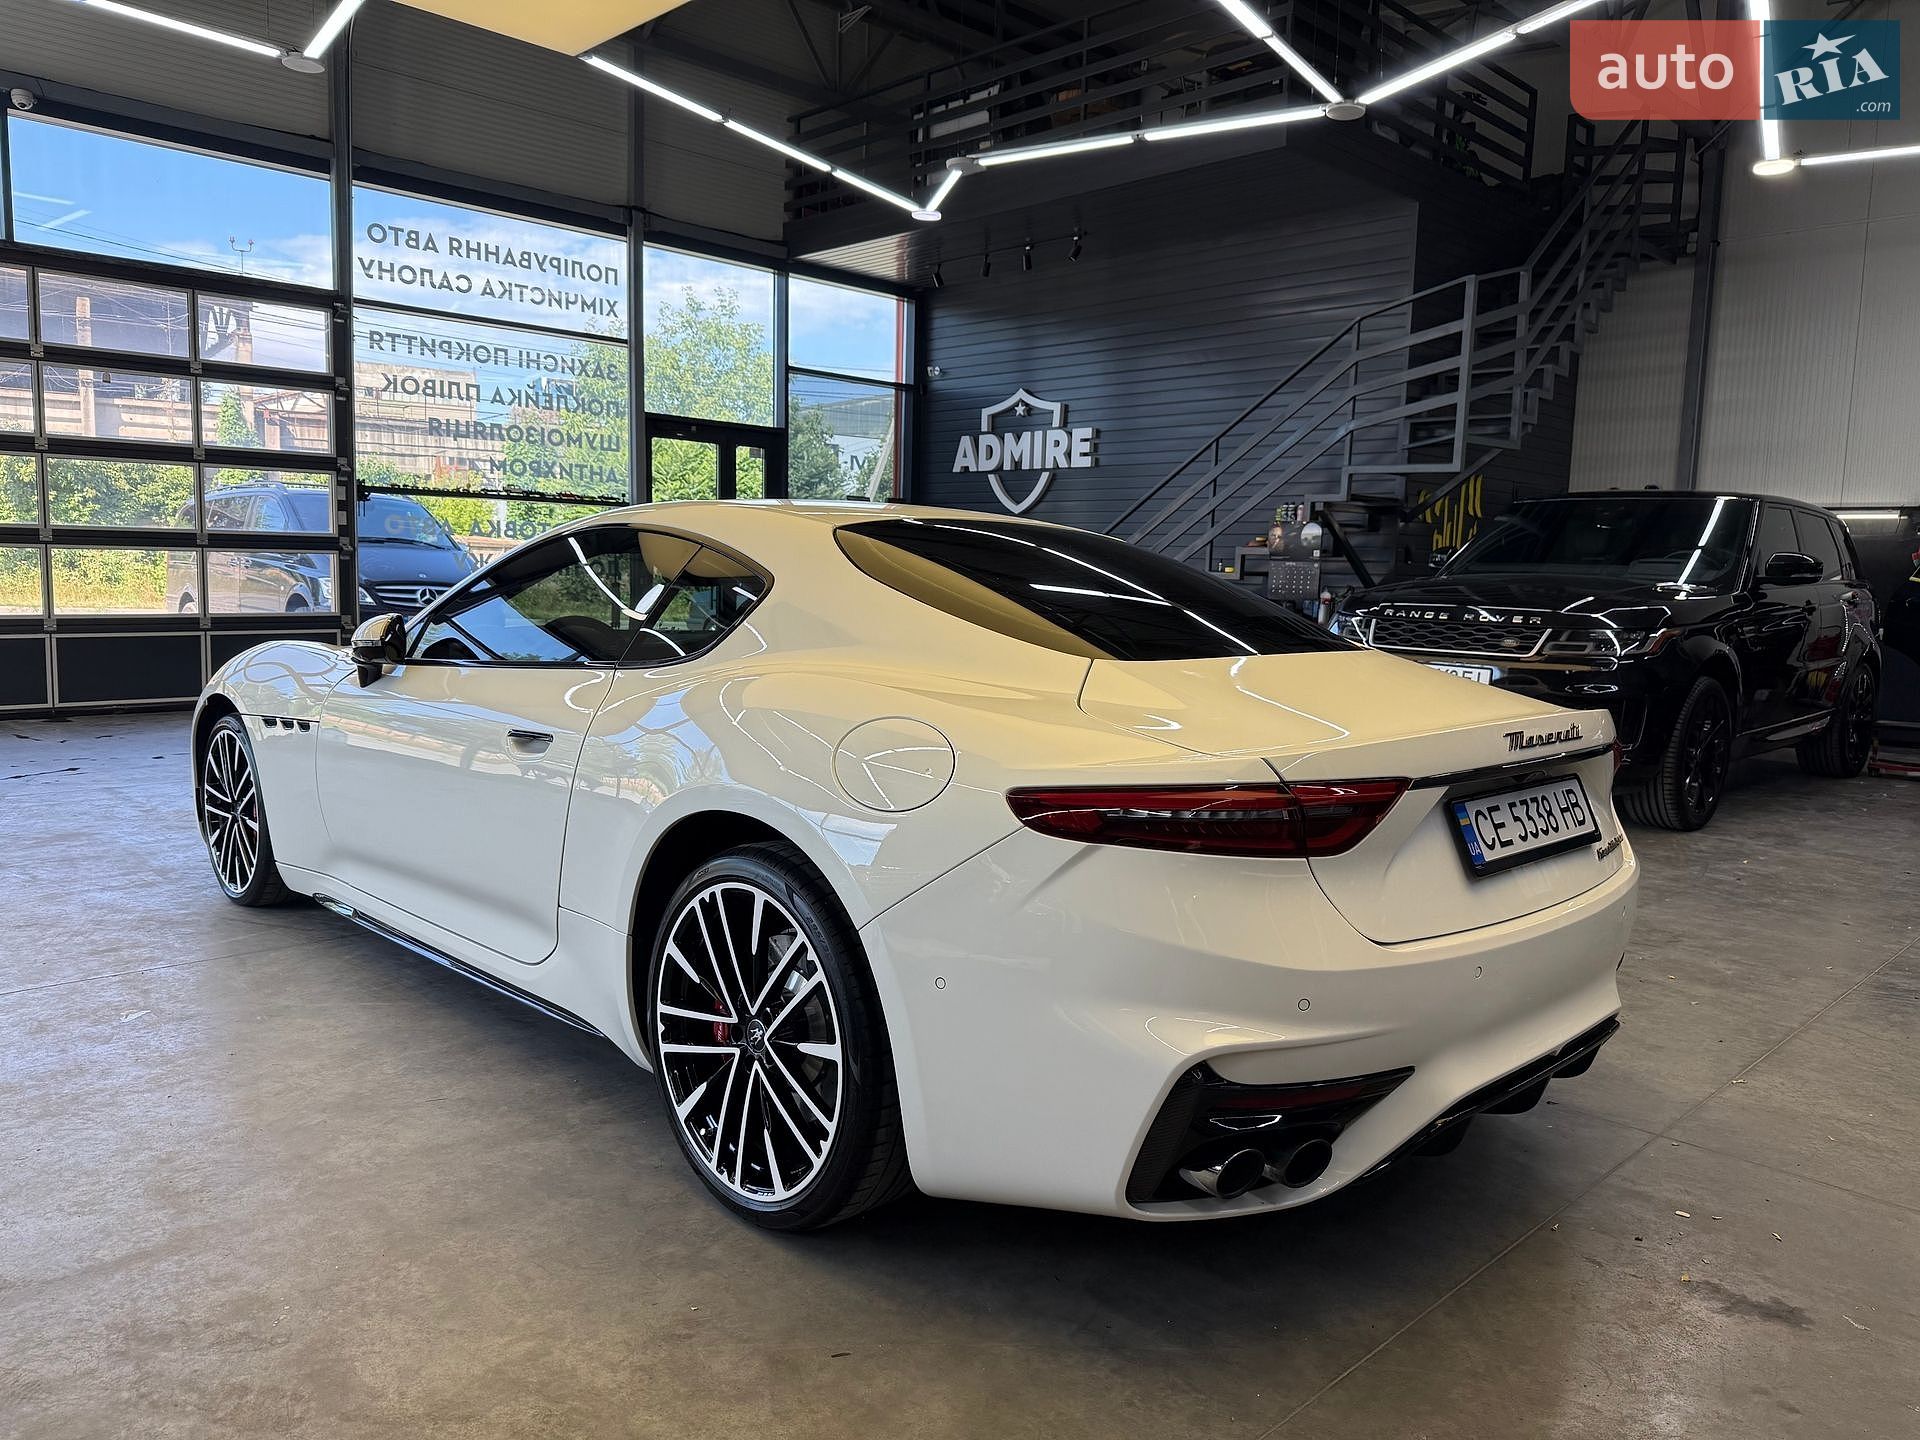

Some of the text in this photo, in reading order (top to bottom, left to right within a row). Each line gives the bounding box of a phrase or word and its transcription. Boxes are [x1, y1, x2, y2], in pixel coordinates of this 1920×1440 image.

[952, 427, 1096, 473] ADMIRE
[1383, 608, 1544, 625] RANGE ROVER
[1503, 722, 1584, 752] Maserati
[1474, 787, 1587, 852] CE 5338 HB
[1467, 841, 1482, 856] UA
